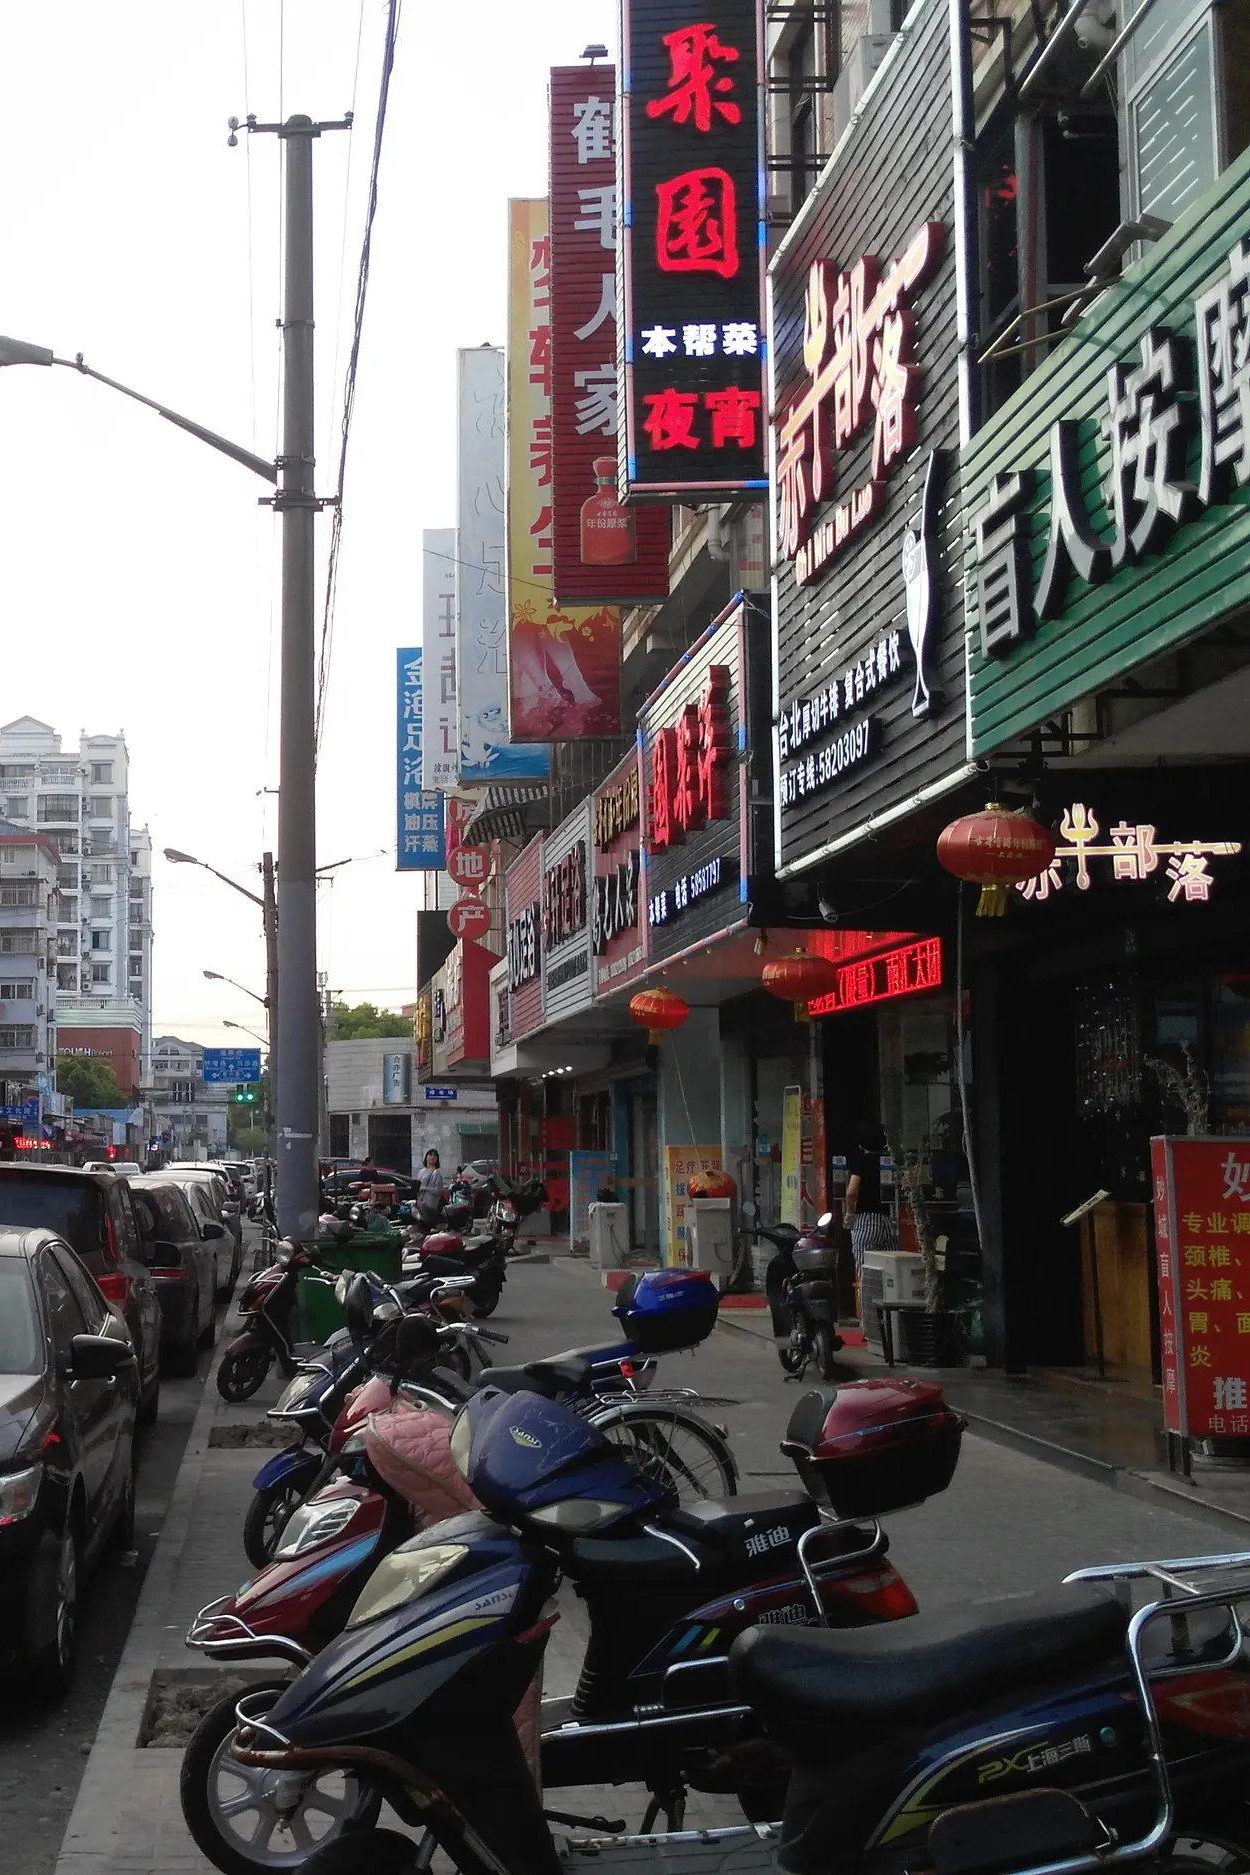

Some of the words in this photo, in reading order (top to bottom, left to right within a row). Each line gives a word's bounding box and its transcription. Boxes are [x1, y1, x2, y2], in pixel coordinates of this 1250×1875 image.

[641, 323, 758, 357] 本帮菜
[643, 386, 759, 450] 夜宵
[968, 238, 1250, 660] 盲人按摩
[587, 518, 627, 529] 年份原浆
[404, 834, 440, 853] 汗蒸
[675, 1160, 695, 1174] 足疗
[1182, 1212, 1250, 1234] 专业调
[1156, 1176, 1175, 1394] 妙城盲人按摩
[1190, 1344, 1212, 1367] 炎
[1213, 1376, 1248, 1410] 推
[1208, 1415, 1248, 1433] 电话
[744, 1525, 792, 1557] 雅迪
